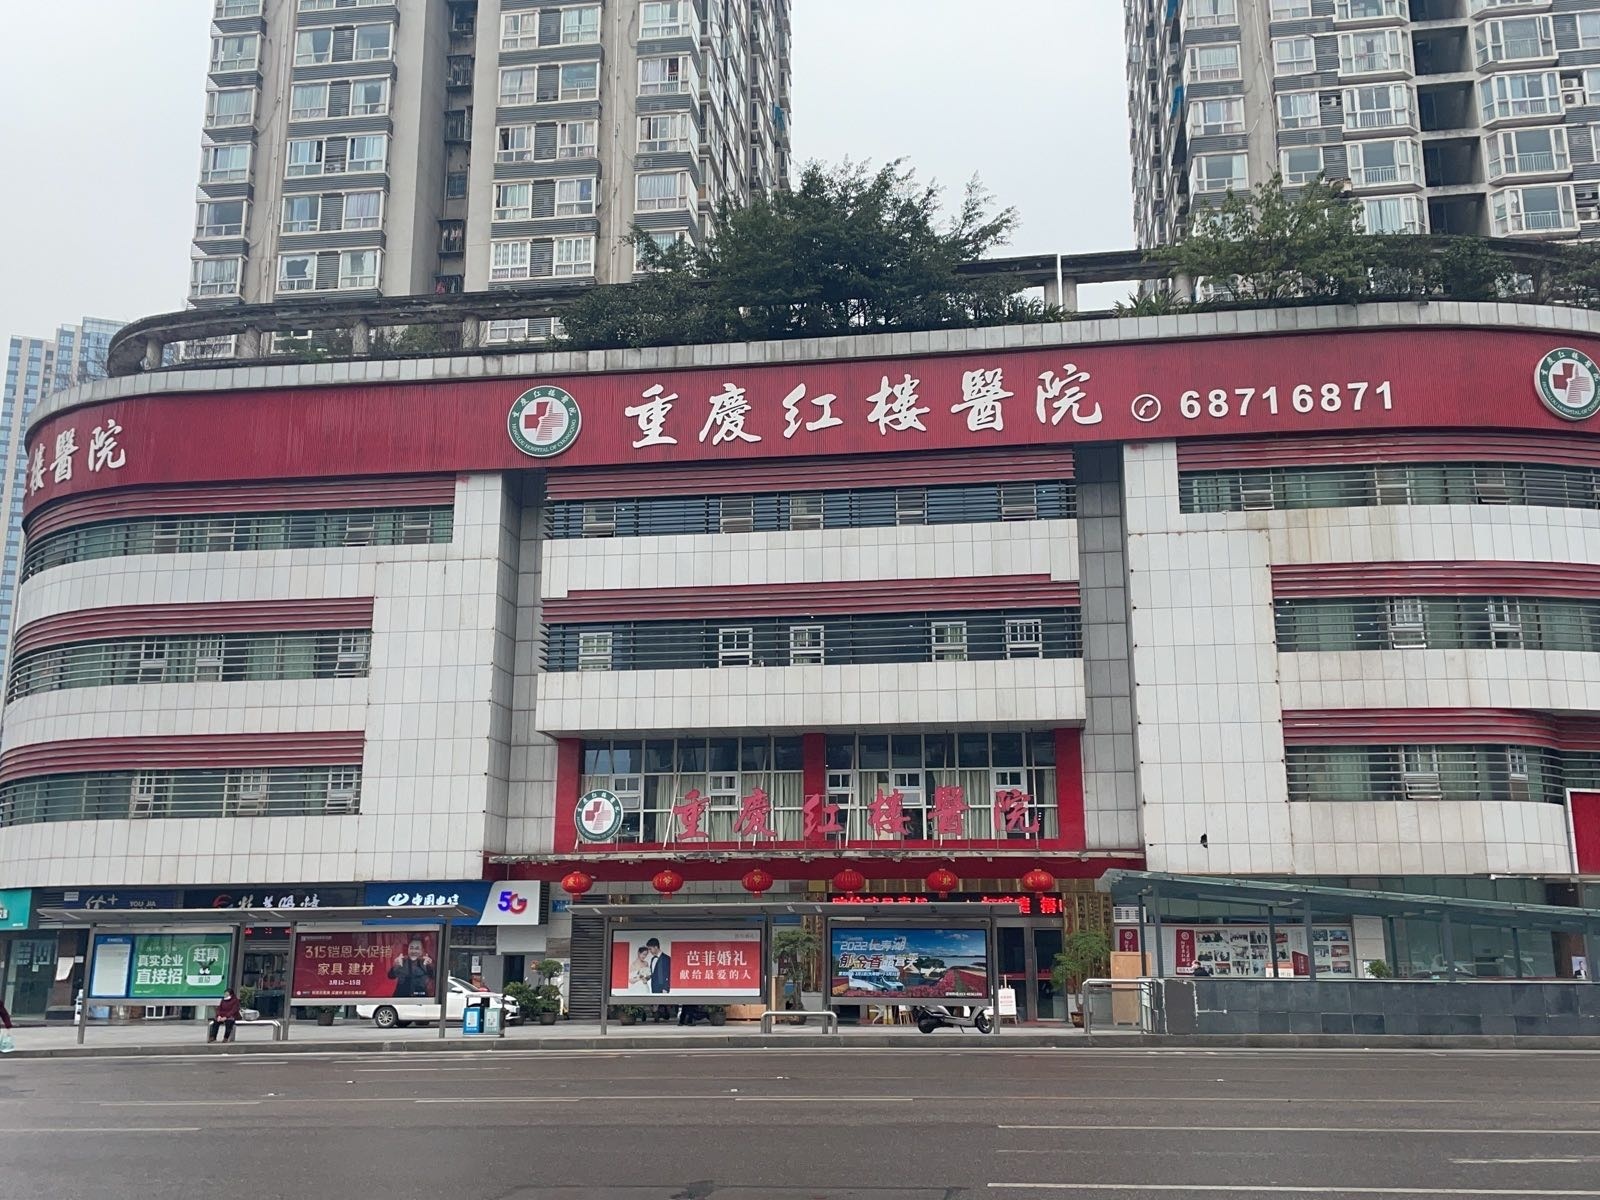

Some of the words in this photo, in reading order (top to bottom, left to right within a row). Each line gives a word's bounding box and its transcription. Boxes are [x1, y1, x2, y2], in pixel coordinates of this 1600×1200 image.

[1180, 381, 1393, 419] 68716871
[411, 893, 460, 906] 中国电信
[497, 891, 528, 915] 5G
[138, 954, 184, 967] 真实企业
[686, 950, 748, 967] 芭菲婚礼
[135, 967, 183, 985] 直接招
[317, 962, 344, 976] 家具
[347, 962, 375, 976] 建材
[679, 969, 752, 980] 献给最爱的人
